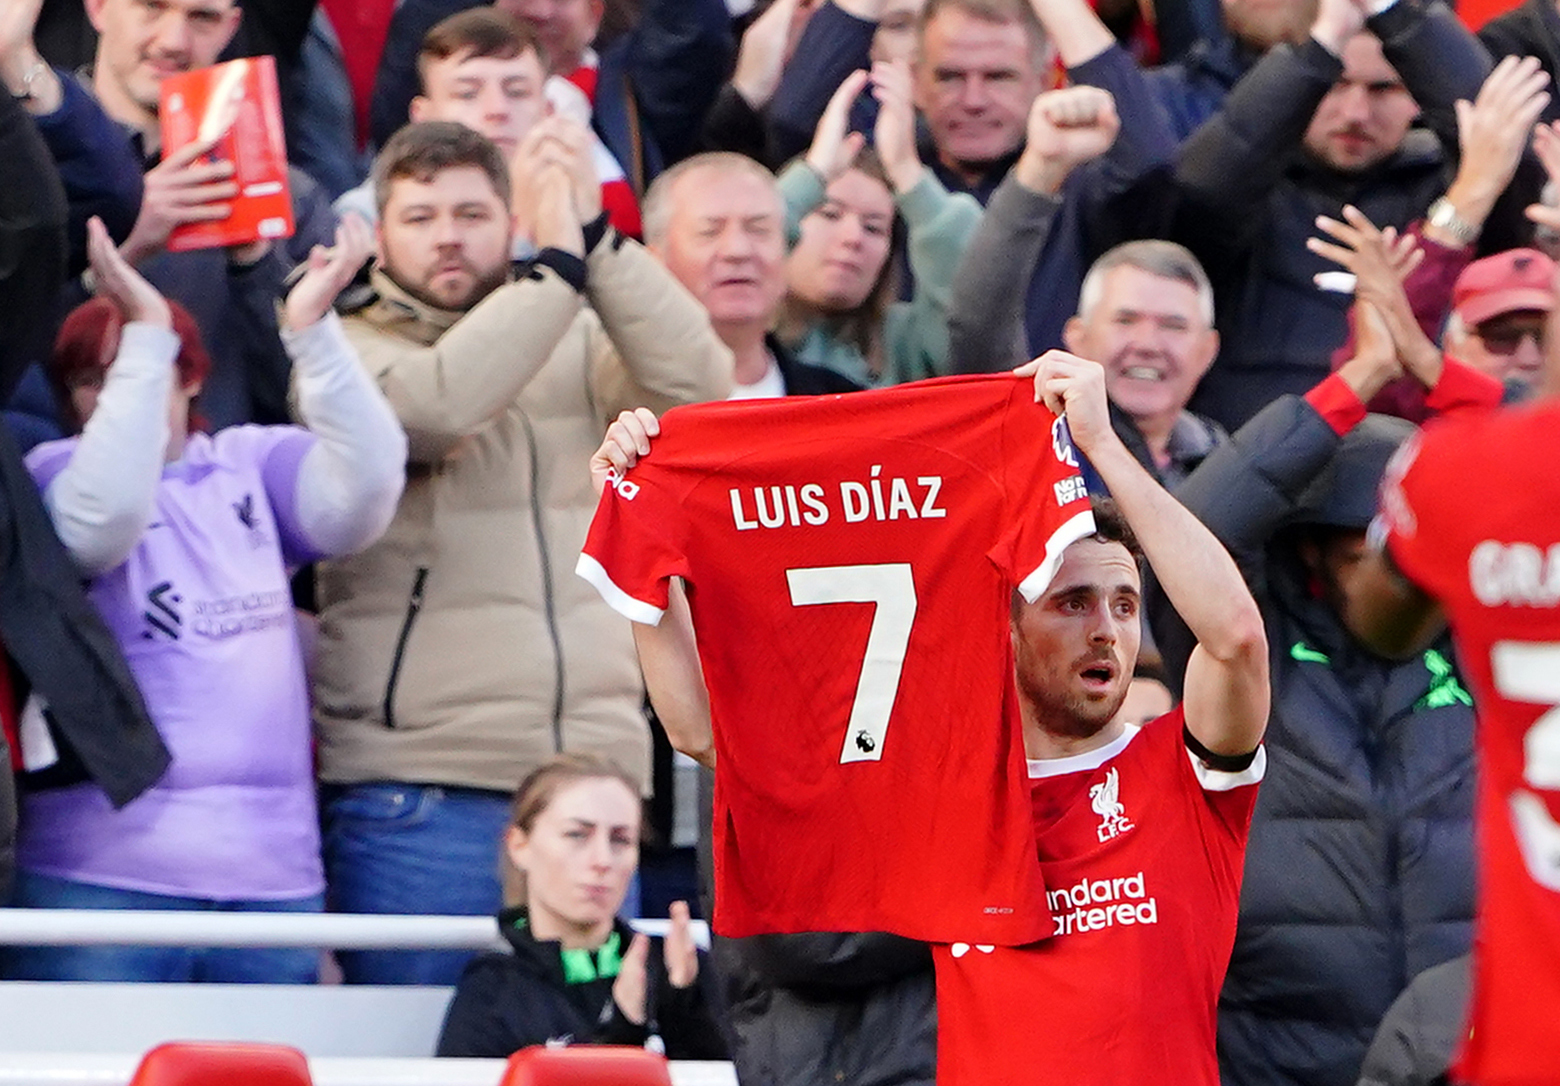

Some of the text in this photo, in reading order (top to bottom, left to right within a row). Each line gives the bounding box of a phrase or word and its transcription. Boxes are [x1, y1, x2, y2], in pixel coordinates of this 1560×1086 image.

[729, 464, 947, 531] LUIS DÍAZ
[786, 563, 917, 764] 7
[1046, 872, 1145, 911] ndard
[1053, 898, 1157, 936] artered
